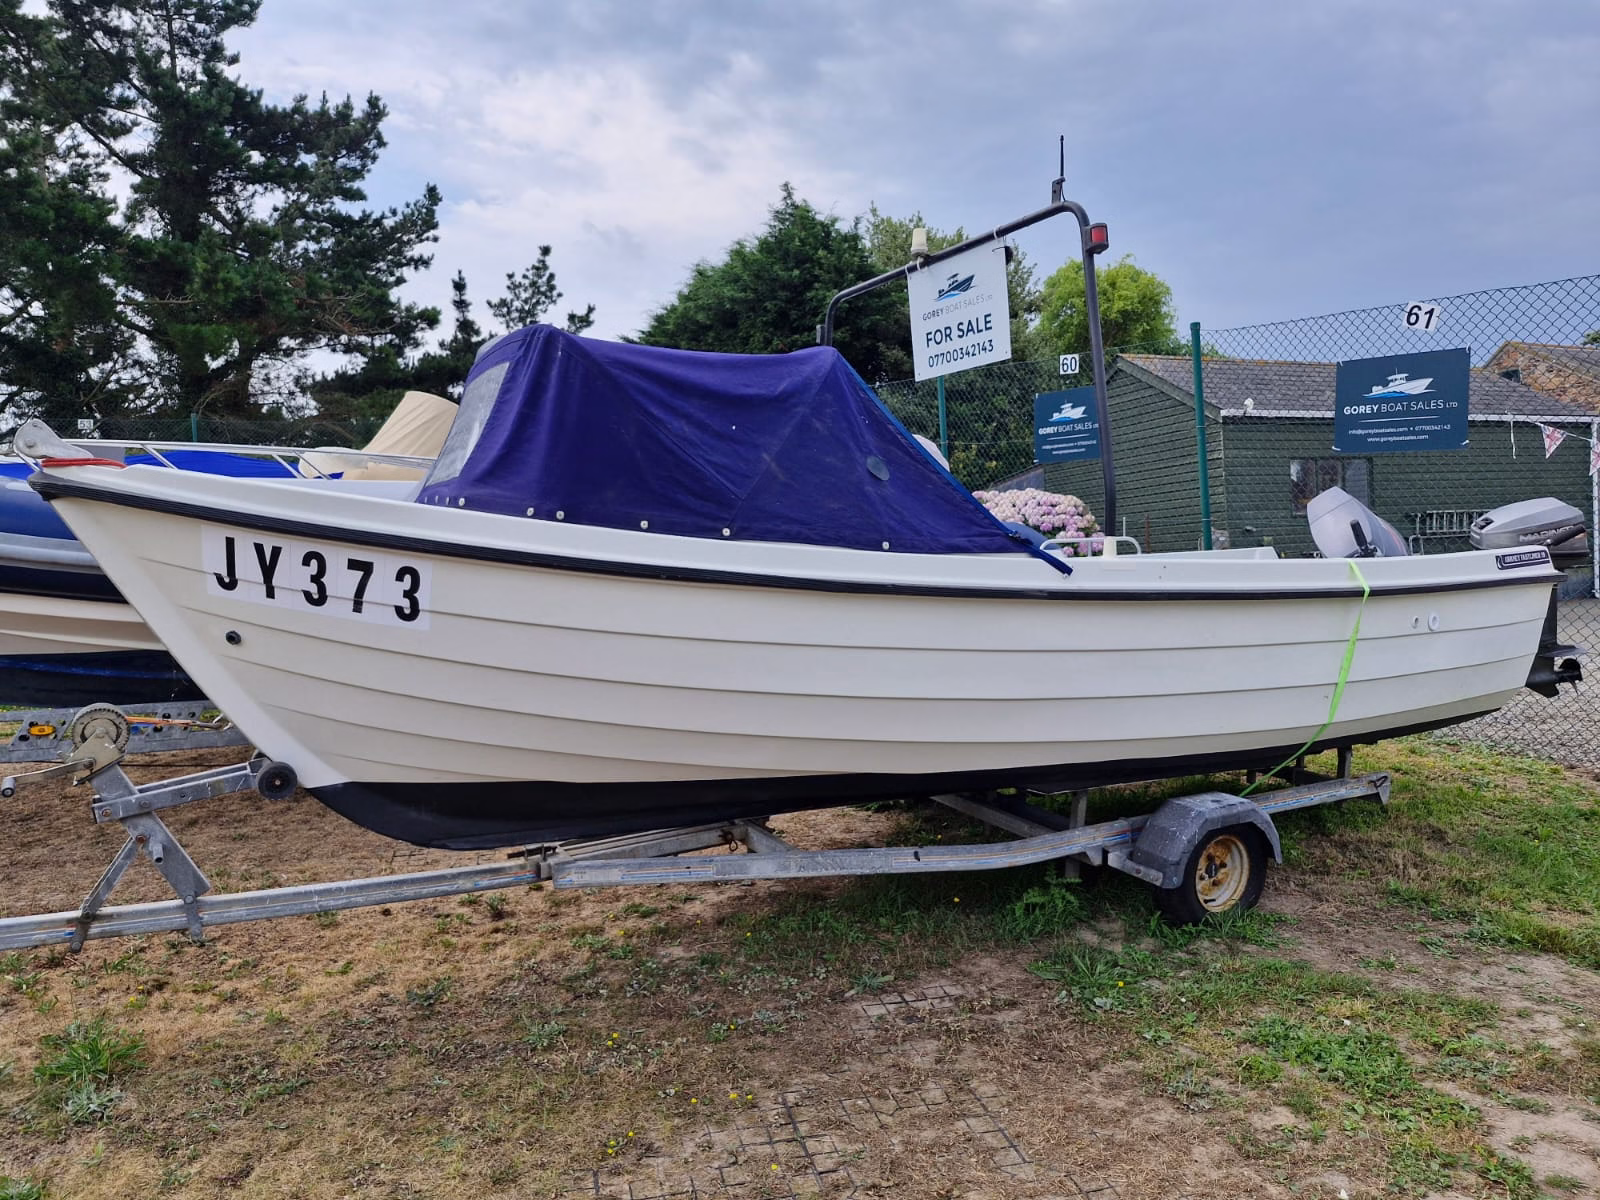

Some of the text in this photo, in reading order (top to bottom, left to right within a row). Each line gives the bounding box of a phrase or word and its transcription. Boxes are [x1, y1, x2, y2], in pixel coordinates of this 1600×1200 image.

[922, 308, 944, 321] GOREY
[945, 301, 962, 315] BOAT
[963, 294, 985, 309] SALES
[1406, 304, 1435, 330] 61
[925, 313, 993, 348] FOR SALE
[928, 339, 994, 368] 07700342143
[1061, 356, 1077, 372] 60
[1343, 399, 1458, 415] GOREY BOAT SALES LTD
[1073, 422, 1092, 431] SALES
